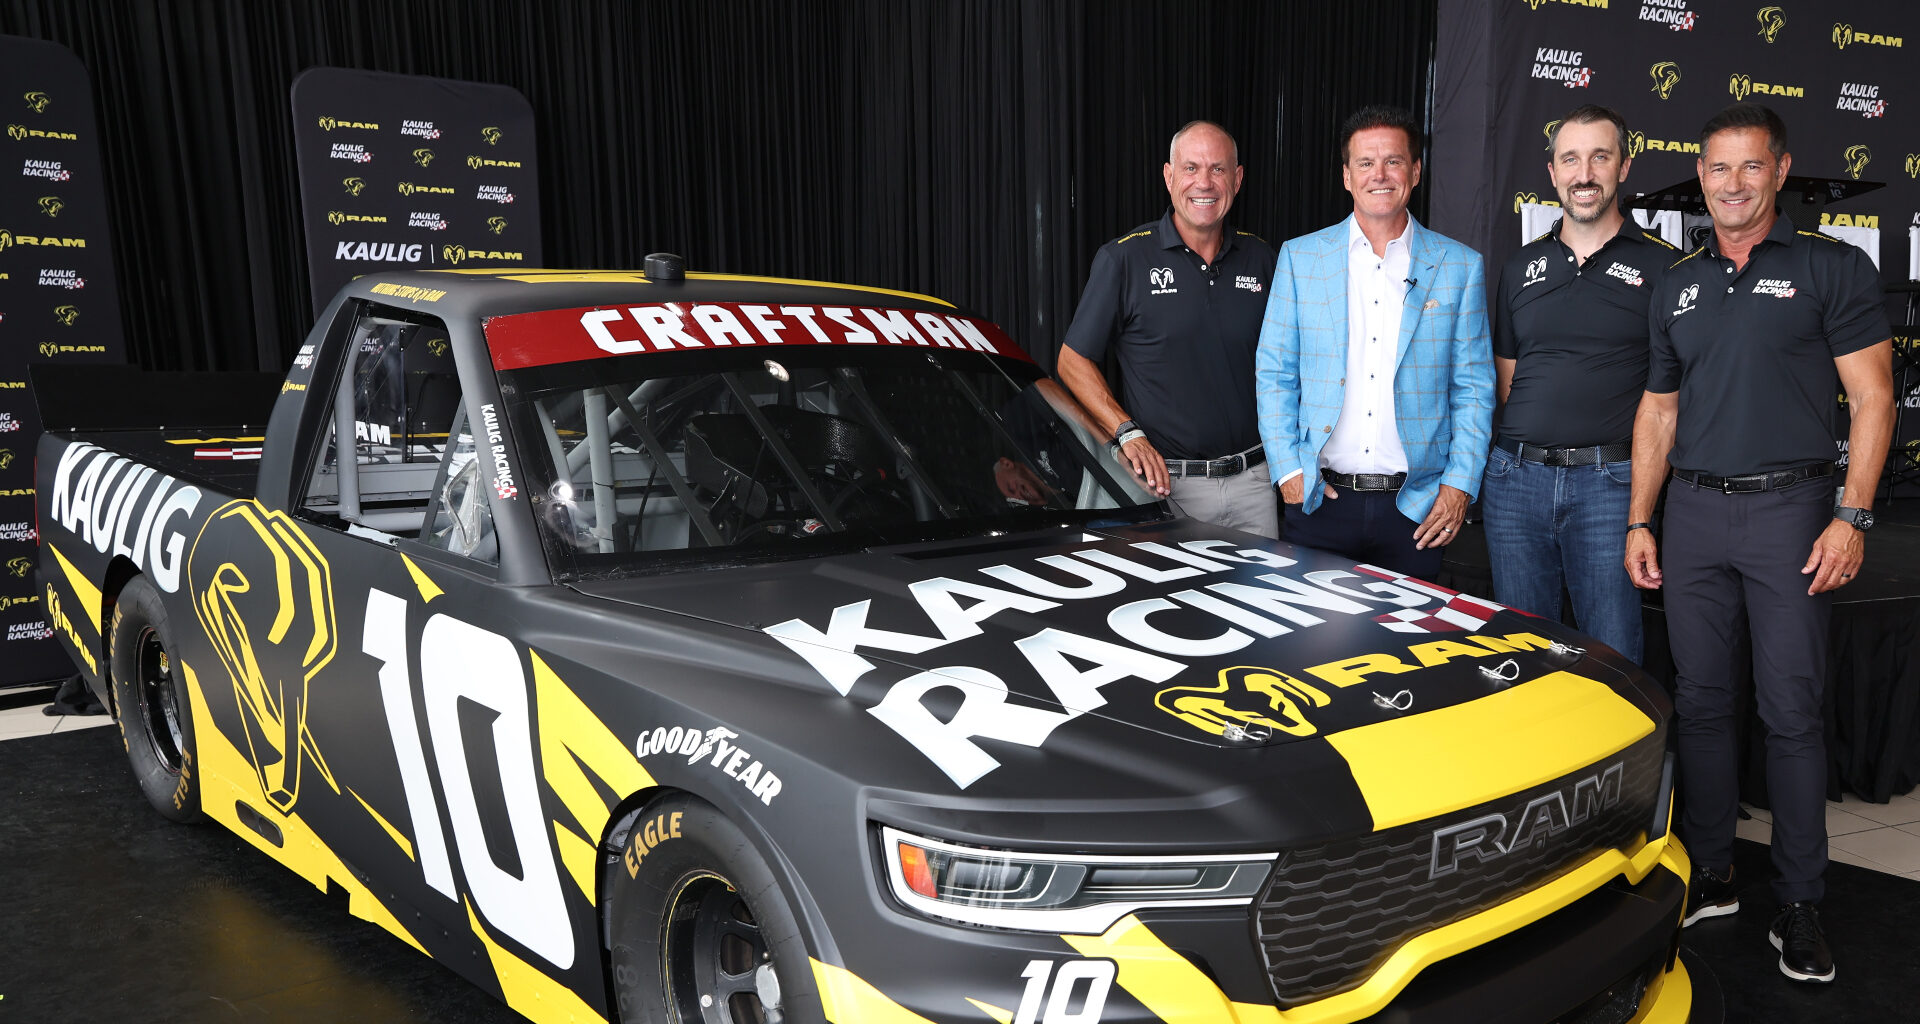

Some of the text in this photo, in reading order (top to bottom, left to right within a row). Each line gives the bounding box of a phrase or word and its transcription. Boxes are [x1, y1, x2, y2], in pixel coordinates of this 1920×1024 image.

[1639, 6, 1684, 24] RACING
[1854, 32, 1903, 48] RAM
[1535, 47, 1583, 66] KAULIG
[1531, 63, 1581, 82] RACING
[1753, 83, 1804, 98] RAM
[1840, 82, 1879, 98] KAULIG
[1836, 97, 1877, 113] RACING
[337, 121, 378, 130] RAM
[402, 120, 433, 129] KAULIG
[30, 129, 77, 140] RAM
[401, 128, 432, 137] RACING
[332, 143, 364, 152] KAULIG
[1647, 139, 1700, 154] RAM
[330, 151, 363, 161] RACING
[25, 159, 61, 169] KAULIG
[484, 159, 521, 168] RAM
[23, 168, 61, 178] RACING
[416, 185, 455, 194] RAM
[478, 185, 507, 194] KAULIG
[477, 193, 506, 201] RACING
[346, 214, 387, 223] RAM
[410, 212, 440, 221] KAULIG
[408, 219, 439, 228] RACING
[15, 235, 86, 248] RAM
[335, 241, 422, 262] KAULIG
[468, 250, 523, 261] RAM
[40, 269, 76, 278] KAULIG
[1236, 275, 1257, 283] KAULIG
[38, 277, 75, 286] RACING
[1756, 279, 1791, 288] KAULIG
[1752, 286, 1789, 296] RACING
[580, 305, 999, 354] CRAFTSMAN
[481, 404, 502, 443] KAULIG
[354, 420, 391, 446] AM
[491, 445, 514, 489] RACING
[52, 442, 202, 593] KAULIG
[0, 522, 28, 532] AULIG
[0, 531, 28, 540] ACING
[13, 596, 39, 604] RA
[761, 539, 1298, 697] KAULIG
[9, 621, 45, 633] KAULIG
[7, 629, 45, 641] RACING
[61, 611, 98, 677] RAM
[1303, 632, 1556, 688] RAM
[865, 570, 1433, 790] RACING
[173, 746, 192, 810] EAGLE
[362, 587, 576, 971] 10
[1428, 761, 1624, 881] RAM
[624, 811, 684, 880] EAGLE
[1013, 960, 1116, 1024] 10
